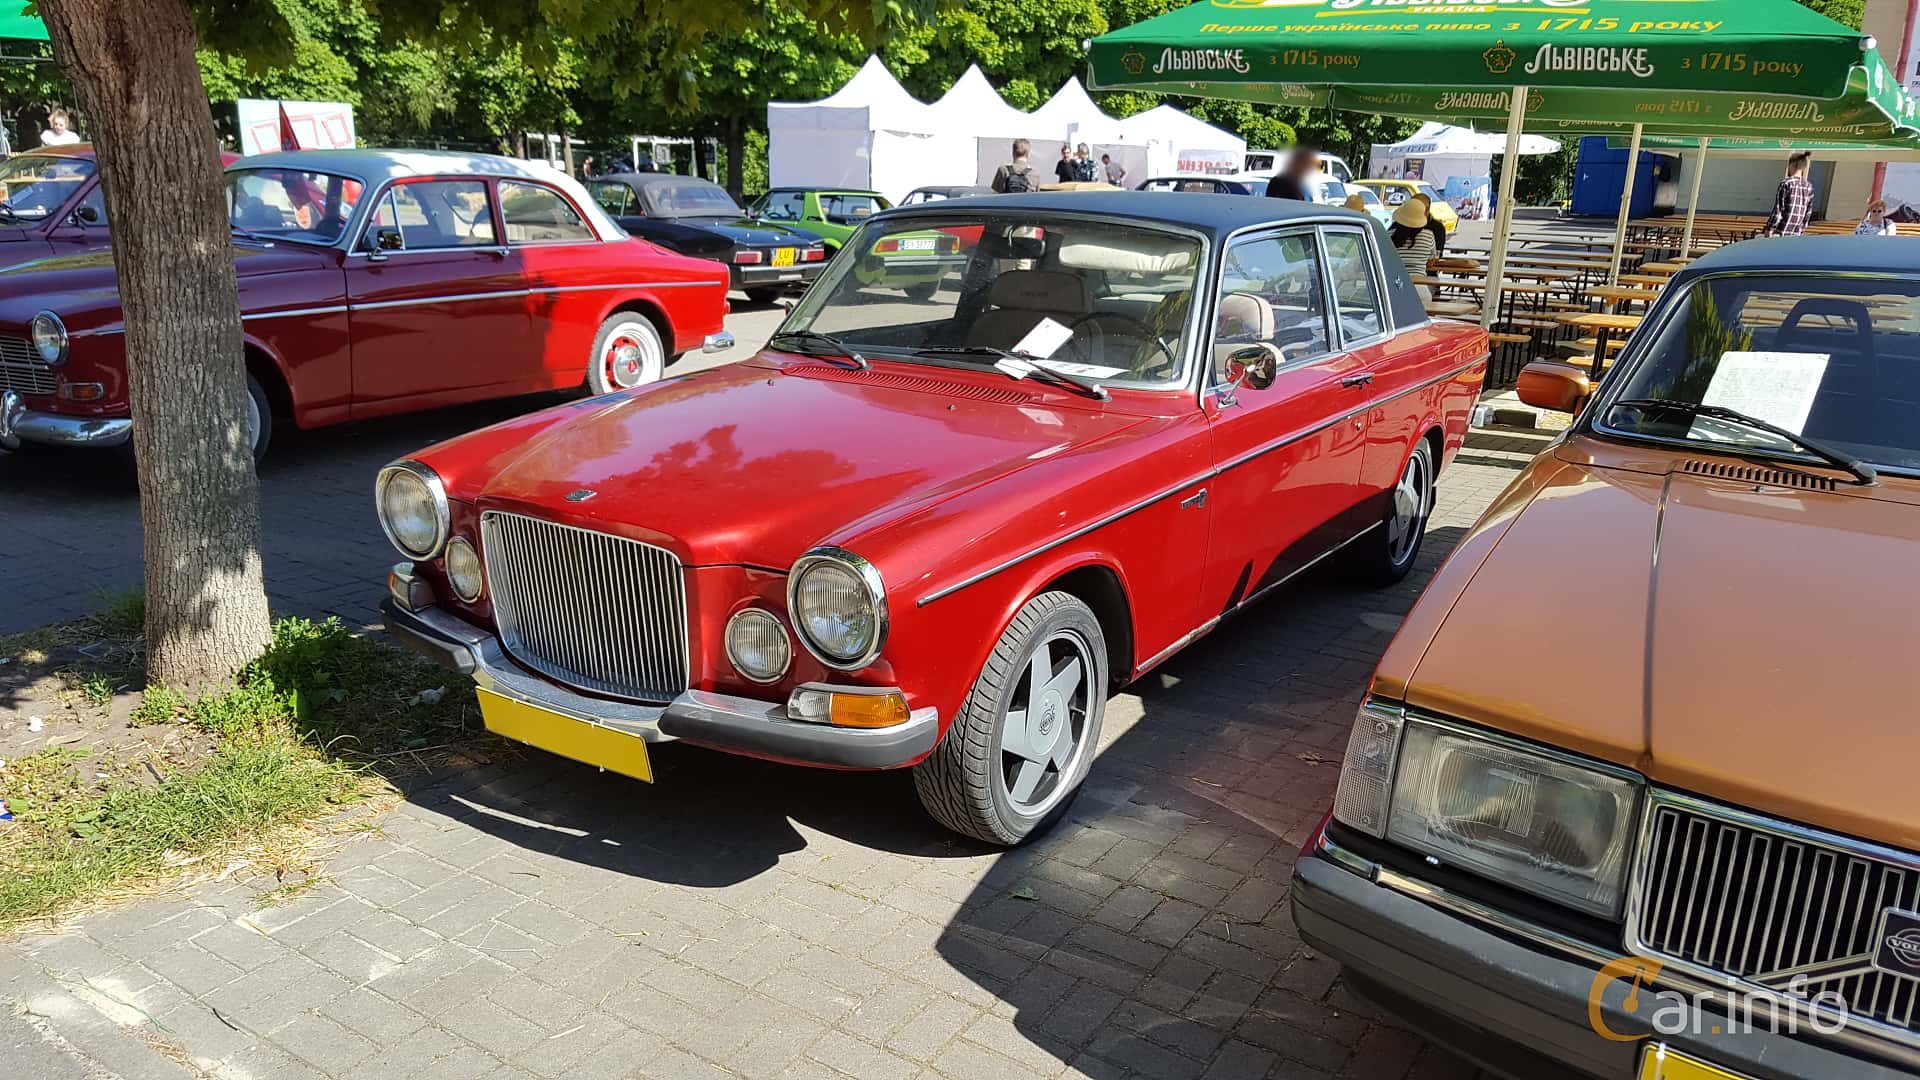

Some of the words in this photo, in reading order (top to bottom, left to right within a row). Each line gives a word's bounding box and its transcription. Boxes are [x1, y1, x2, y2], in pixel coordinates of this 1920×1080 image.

[1200, 23, 1279, 35] Перше
[1280, 22, 1419, 34] українське
[1425, 23, 1492, 31] пиво
[1537, 18, 1620, 31] 1715
[1628, 20, 1724, 33] року
[1152, 46, 1251, 74] ЛЬВІВСЬКЕ
[1283, 49, 1319, 66] 1715
[1322, 53, 1361, 70] року
[1524, 43, 1655, 78] ЛЬВІВСЬКЕ
[1701, 52, 1747, 72] 1715
[1752, 59, 1804, 77] року
